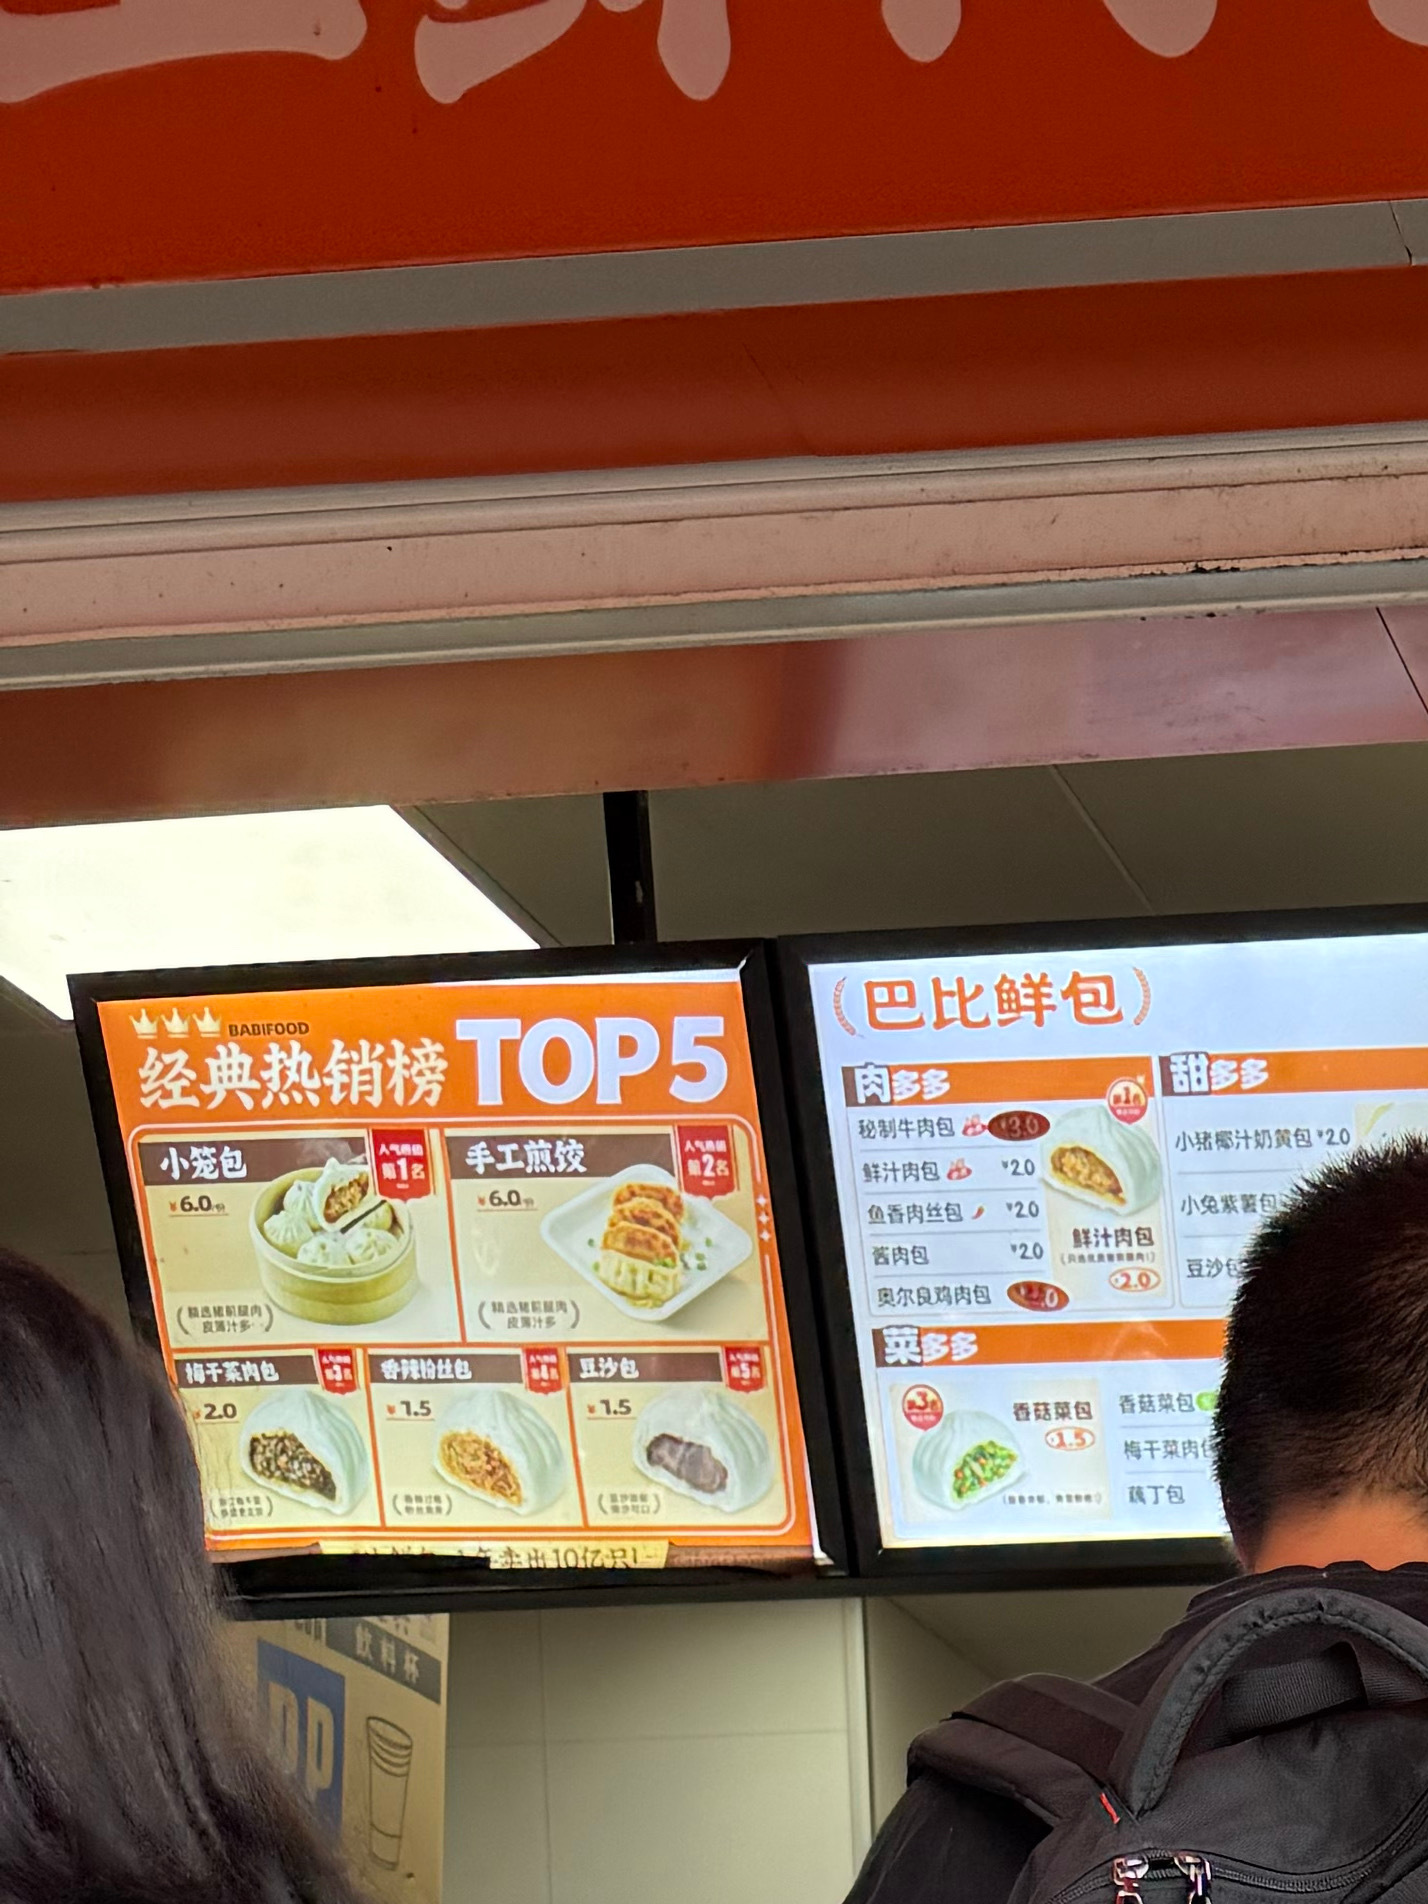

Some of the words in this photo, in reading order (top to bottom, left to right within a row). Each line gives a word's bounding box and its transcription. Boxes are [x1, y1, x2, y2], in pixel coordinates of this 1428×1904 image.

[864, 971, 1123, 1031] 巴比鲜包
[228, 1022, 310, 1037] BABIFOOD
[138, 1038, 449, 1111] 经典热销榜
[856, 1062, 950, 1104] 肉多多
[1170, 1052, 1268, 1094] 甜多多
[161, 1146, 247, 1181] 小笼包
[466, 1139, 588, 1174] 手工煎饺
[862, 1161, 940, 1184] 鲜汁肉包
[882, 1325, 978, 1365] 菜多多
[580, 1358, 639, 1380] 豆沙包
